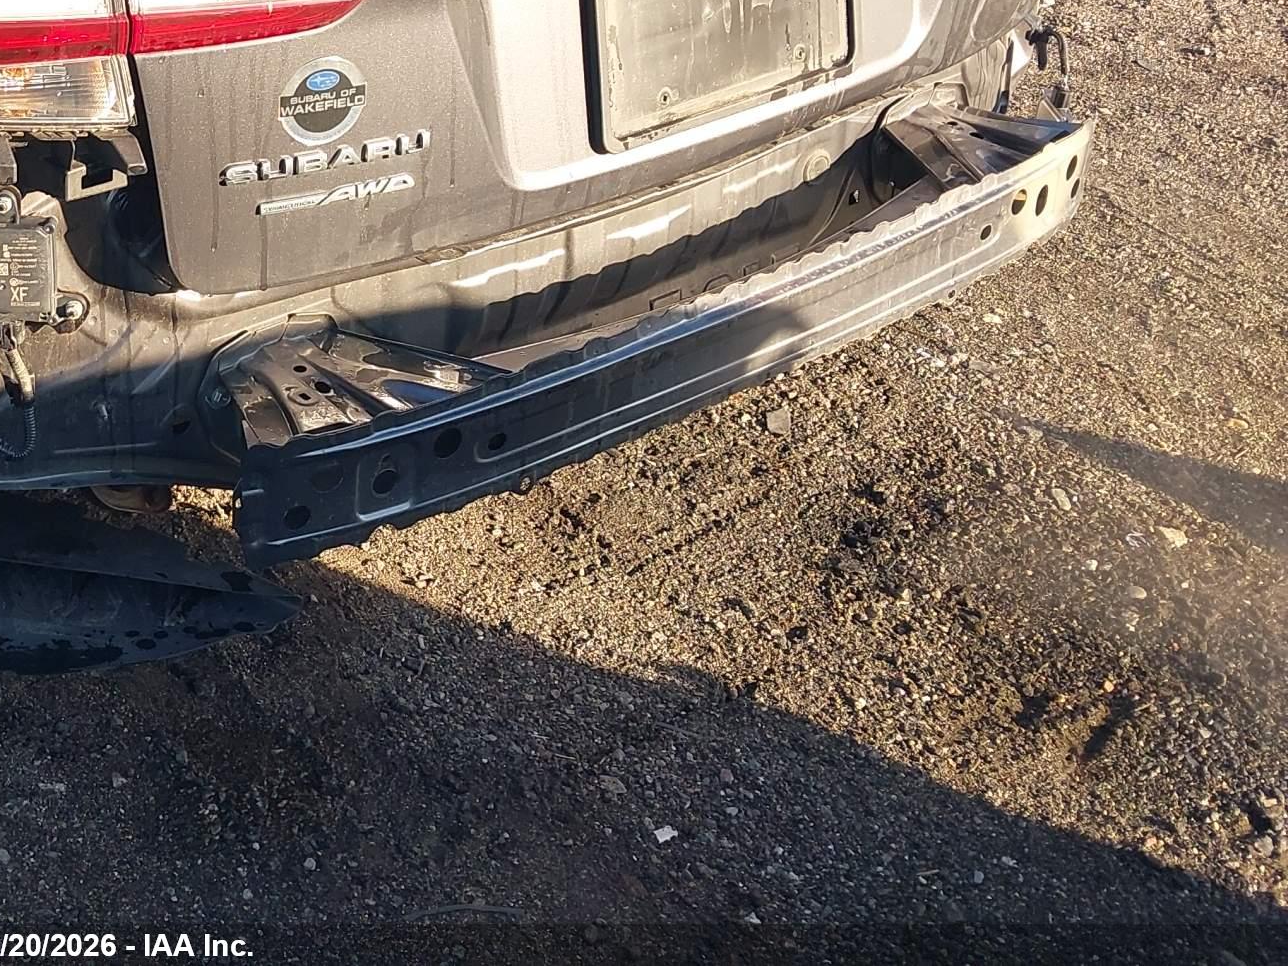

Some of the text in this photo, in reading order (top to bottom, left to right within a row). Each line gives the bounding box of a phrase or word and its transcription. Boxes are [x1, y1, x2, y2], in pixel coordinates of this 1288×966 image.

[280, 95, 365, 117] WAKEFIELD
[290, 87, 357, 105] SUBARU OF
[219, 128, 431, 186] SUBARU
[316, 172, 415, 206] AWD
[10, 286, 29, 302] XF
